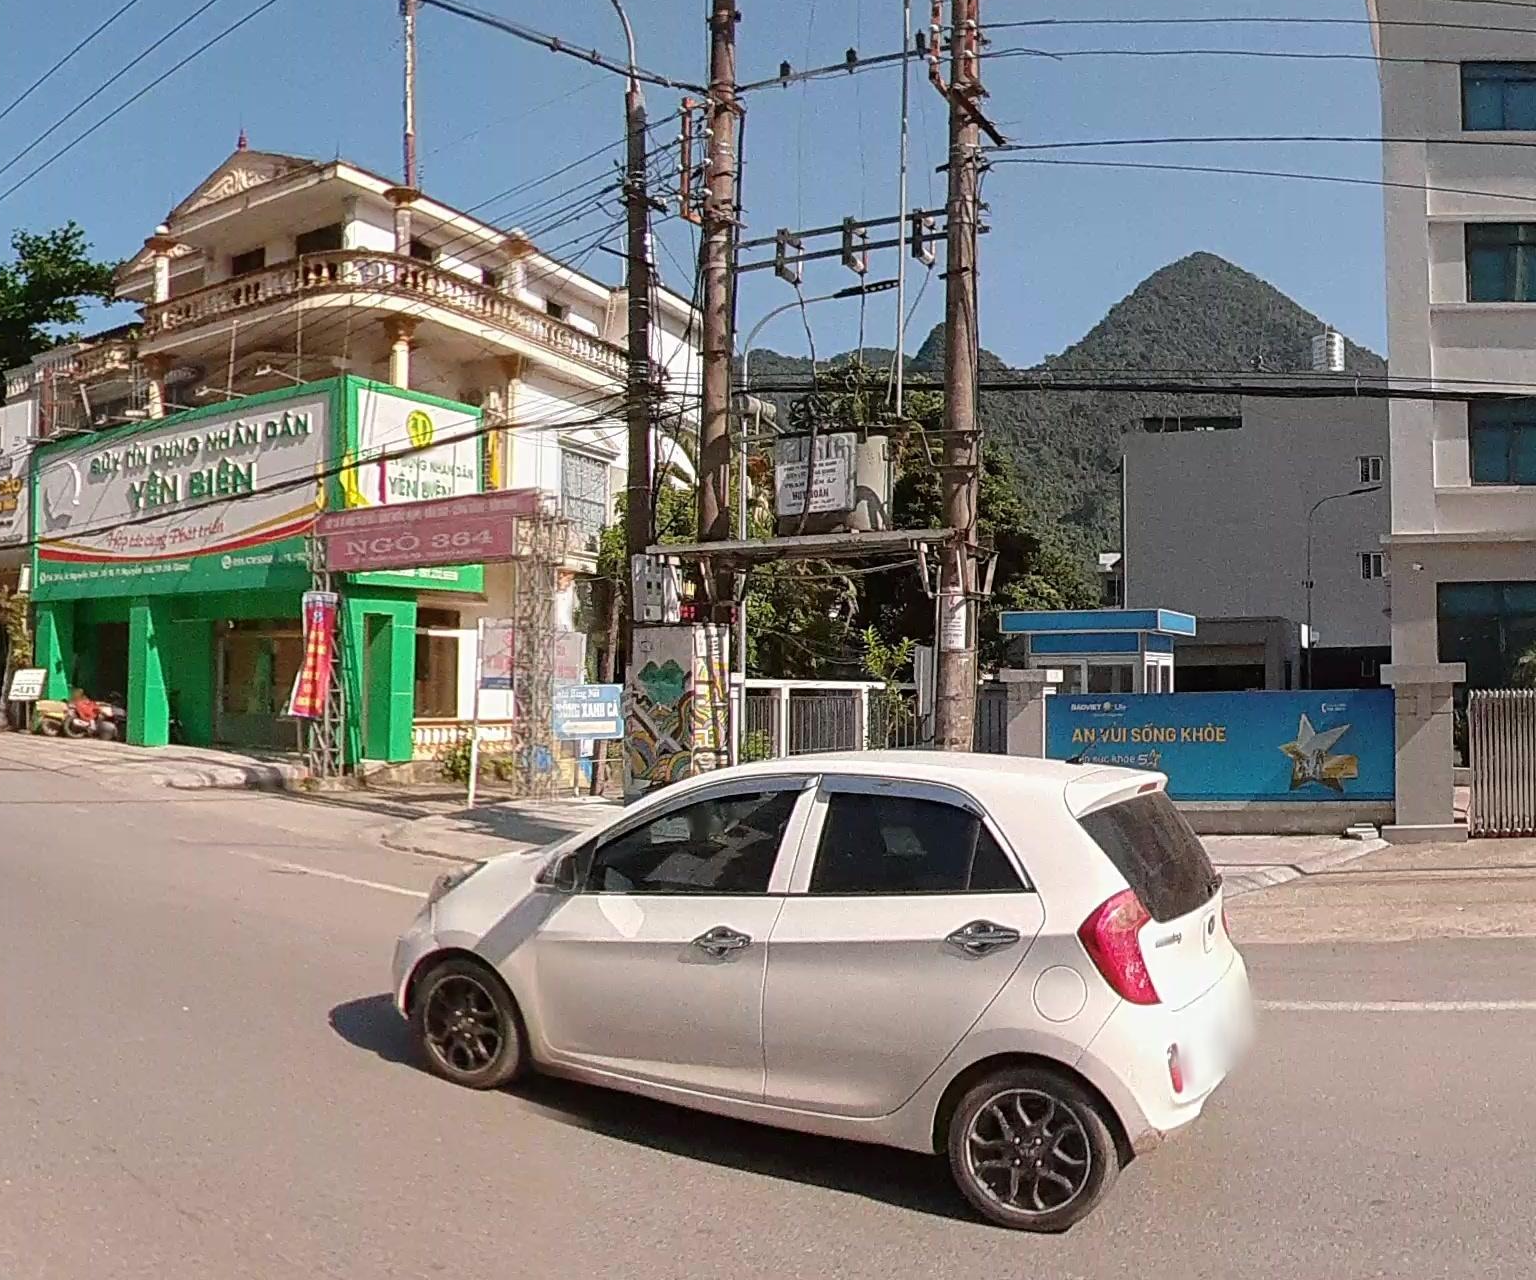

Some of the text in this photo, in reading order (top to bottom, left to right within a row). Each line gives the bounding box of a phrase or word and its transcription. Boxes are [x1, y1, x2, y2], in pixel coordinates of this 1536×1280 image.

[206, 420, 262, 451] NHÂN
[264, 410, 313, 438] DÂN
[132, 468, 182, 509] YÊN
[431, 529, 494, 548] 364
[581, 702, 606, 719] XANH
[1071, 727, 1096, 744] AN
[1131, 722, 1177, 743] SỐNG
